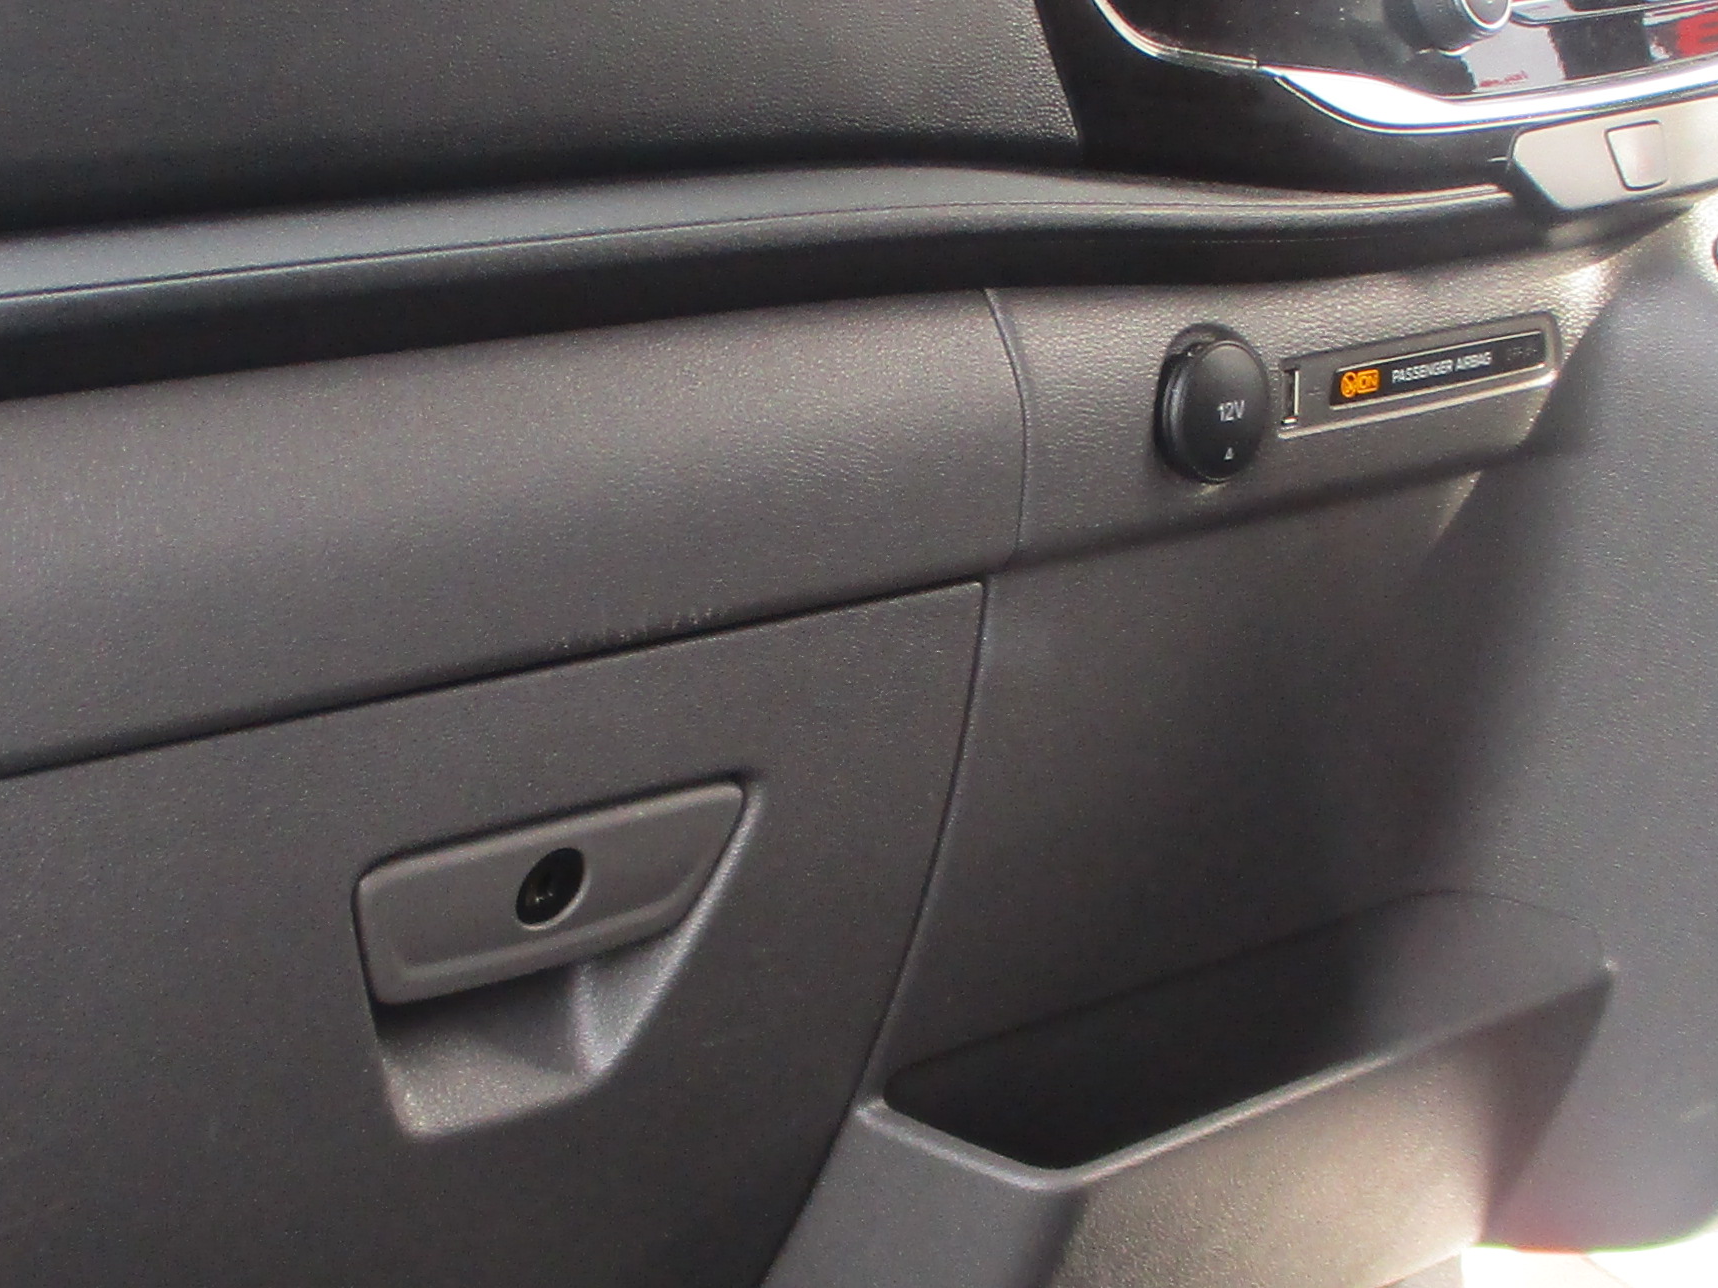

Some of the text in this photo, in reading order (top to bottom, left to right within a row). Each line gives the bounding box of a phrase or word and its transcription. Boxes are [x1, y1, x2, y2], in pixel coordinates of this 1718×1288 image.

[1391, 358, 1454, 385] PASSENGER
[1455, 350, 1494, 372] AIRBAG
[1216, 398, 1246, 423] 12V
